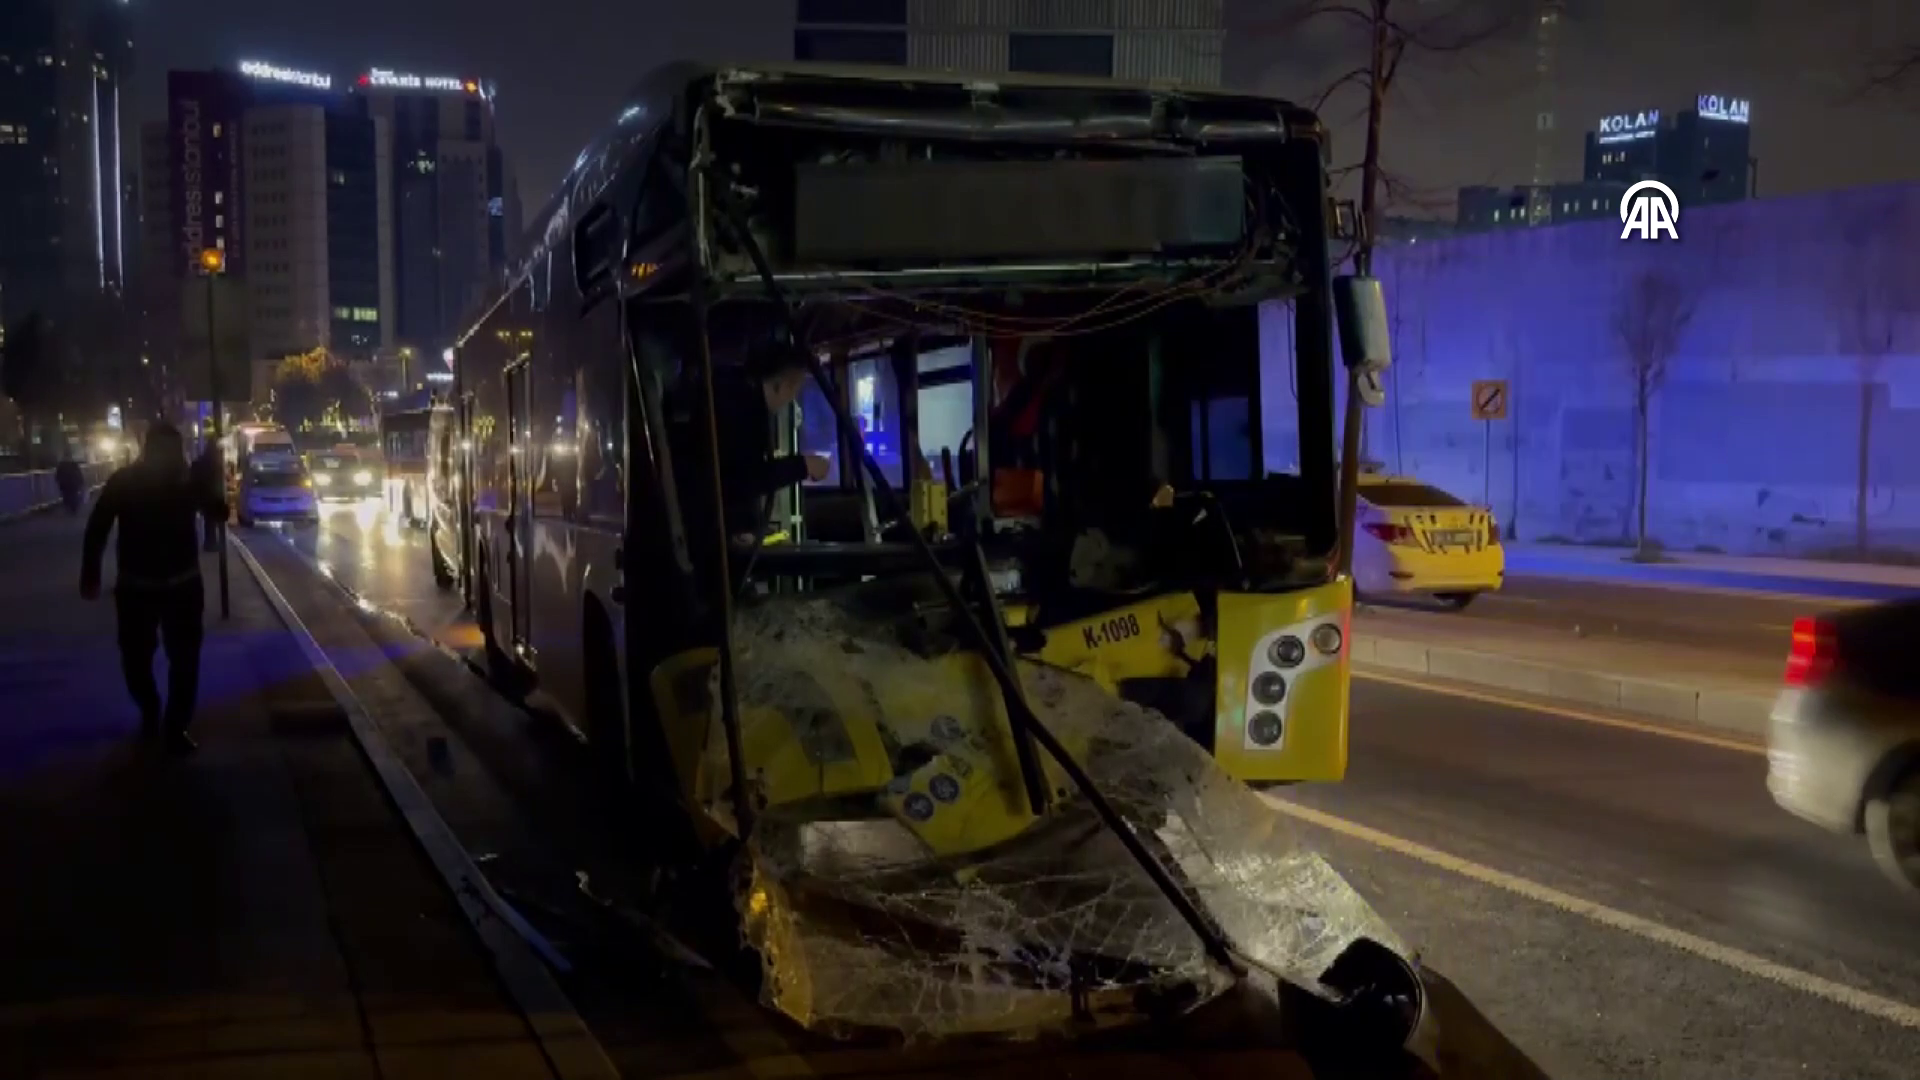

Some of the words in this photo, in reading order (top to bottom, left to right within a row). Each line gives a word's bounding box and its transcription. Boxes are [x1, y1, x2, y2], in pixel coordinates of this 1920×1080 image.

[1698, 95, 1749, 114] KOLAN
[1599, 109, 1659, 133] KOLAN
[1082, 613, 1140, 649] K-1098
